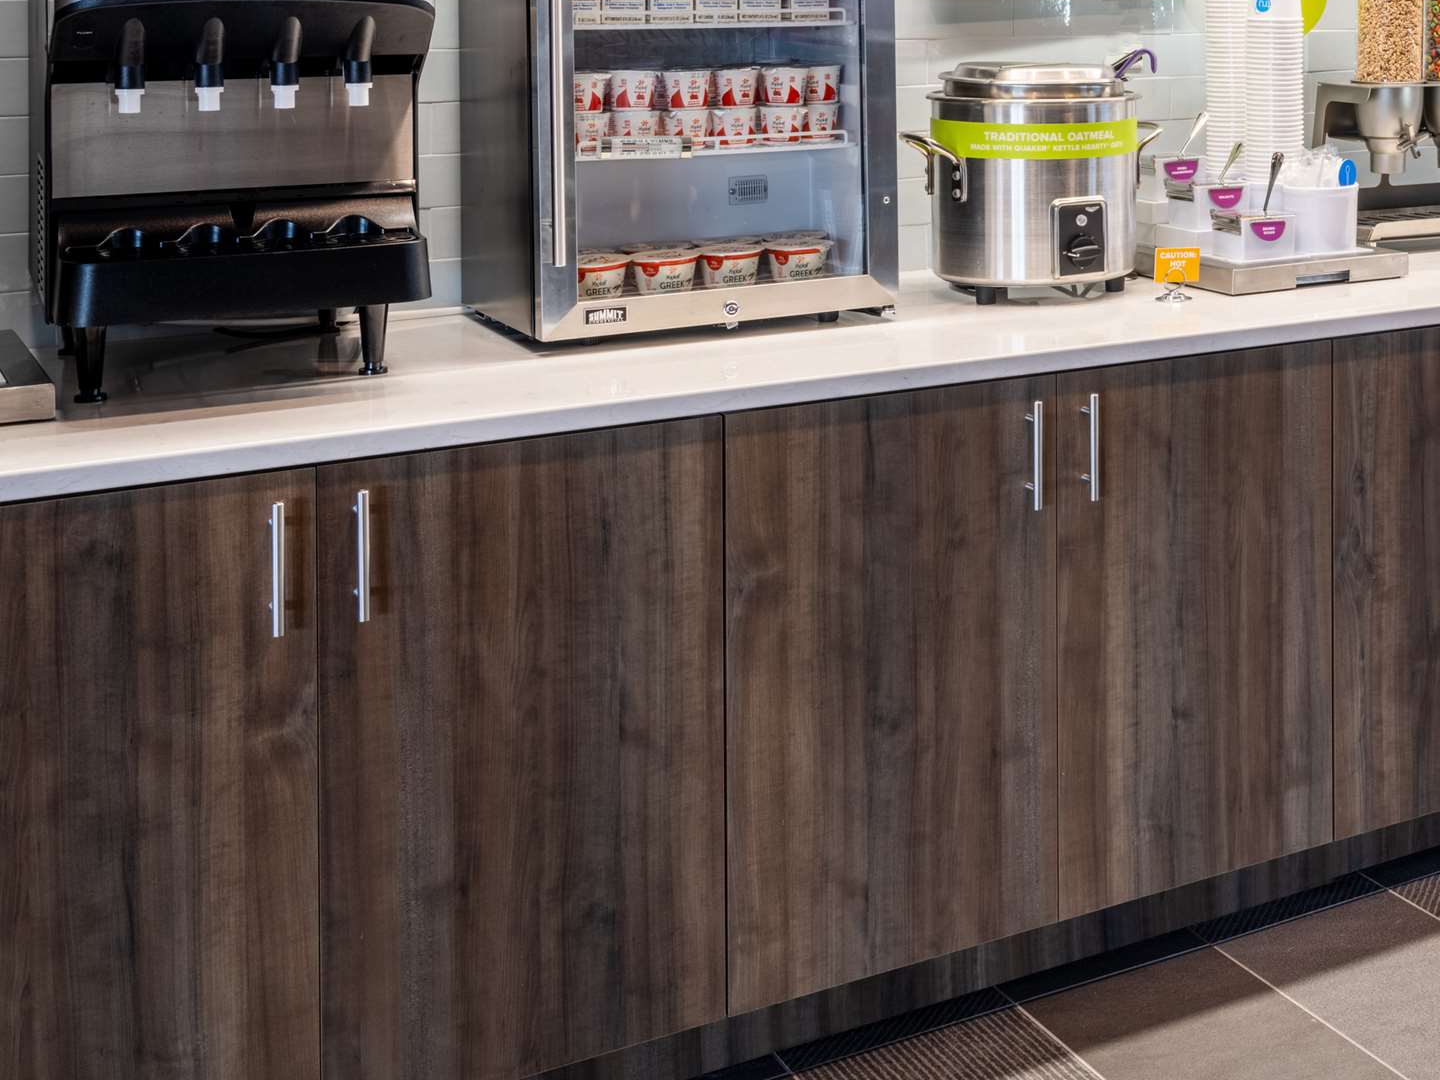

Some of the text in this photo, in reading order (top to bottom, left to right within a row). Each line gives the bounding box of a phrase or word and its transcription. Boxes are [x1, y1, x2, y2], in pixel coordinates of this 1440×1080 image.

[984, 130, 1115, 142] TRADITIONAL OATMEAL
[722, 274, 747, 283] GREEK
[789, 270, 812, 278] GREEK
[660, 281, 684, 290] GREEK
[586, 287, 611, 297] GREEK
[588, 308, 624, 321] SUMMIT
